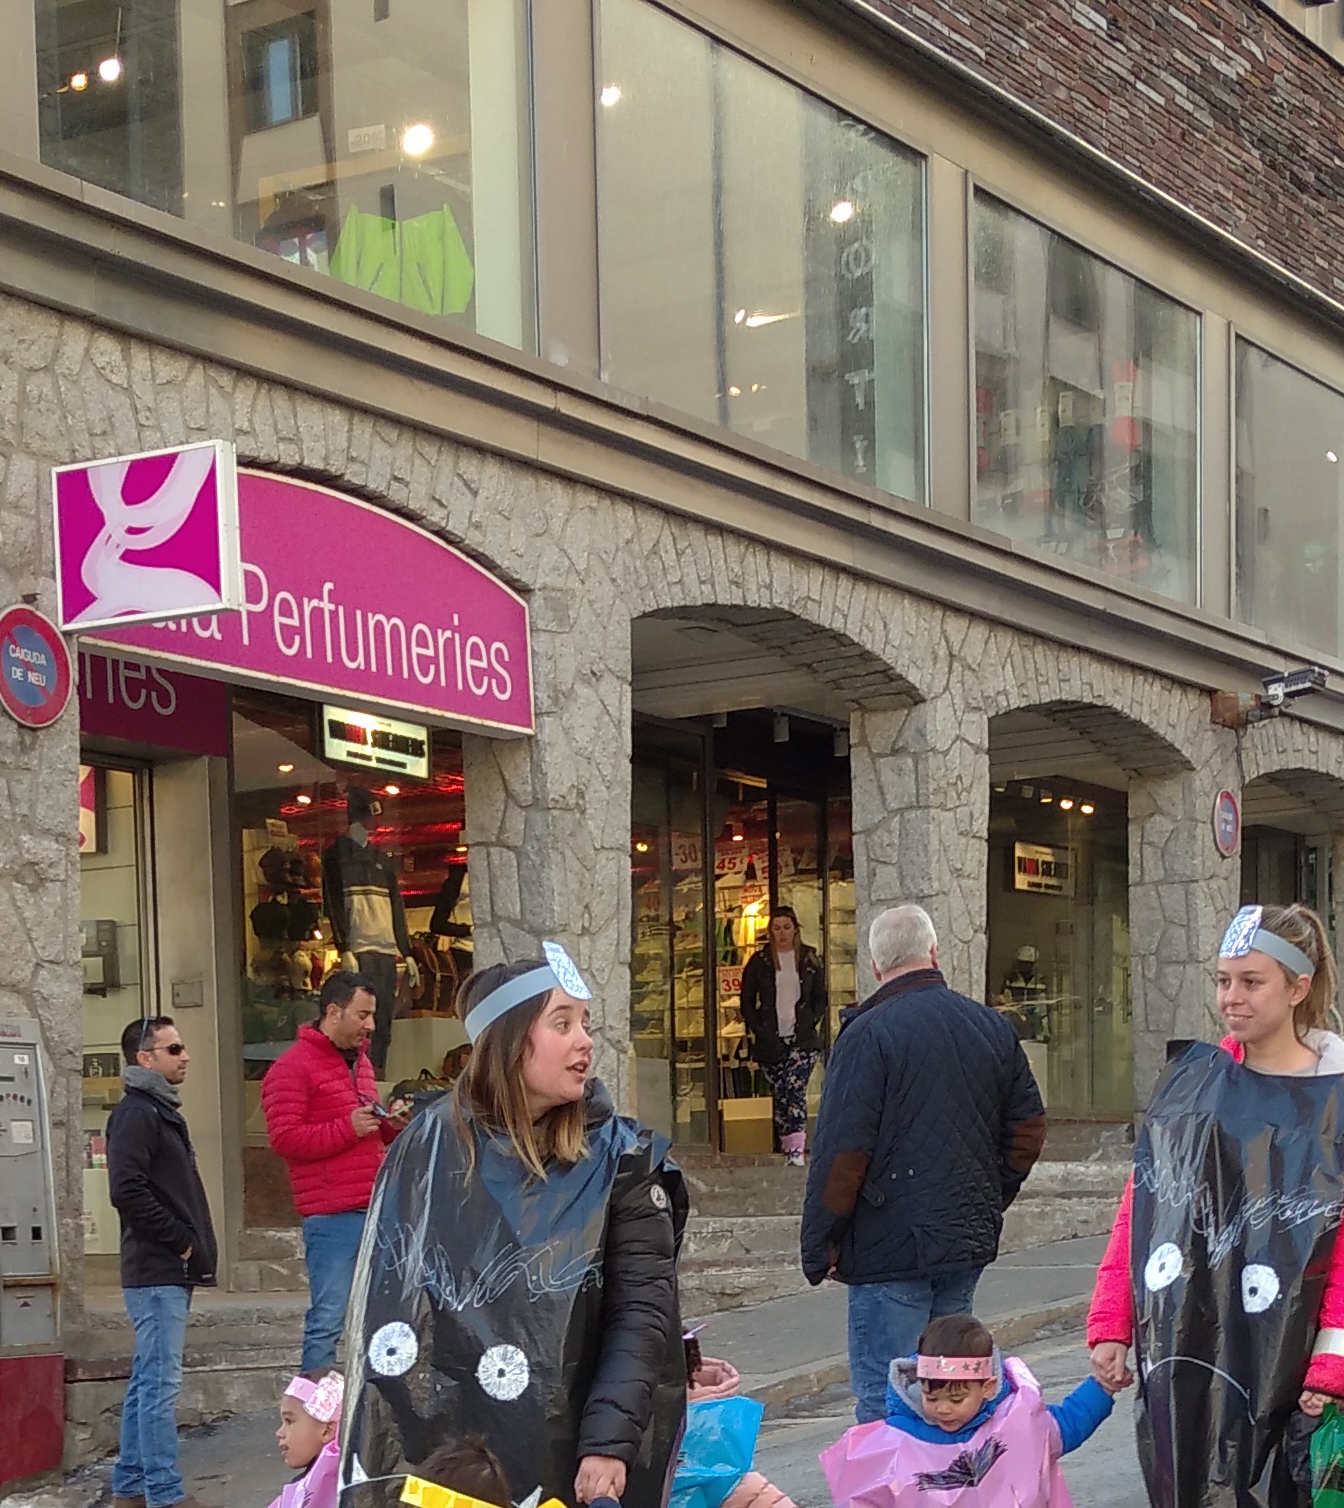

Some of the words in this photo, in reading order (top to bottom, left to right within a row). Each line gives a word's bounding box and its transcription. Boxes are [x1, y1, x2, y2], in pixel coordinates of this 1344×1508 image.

[240, 562, 513, 701] Perfumeries
[8, 644, 48, 666] CAIGUDA
[11, 666, 24, 681] DE
[27, 670, 47, 687] NEU
